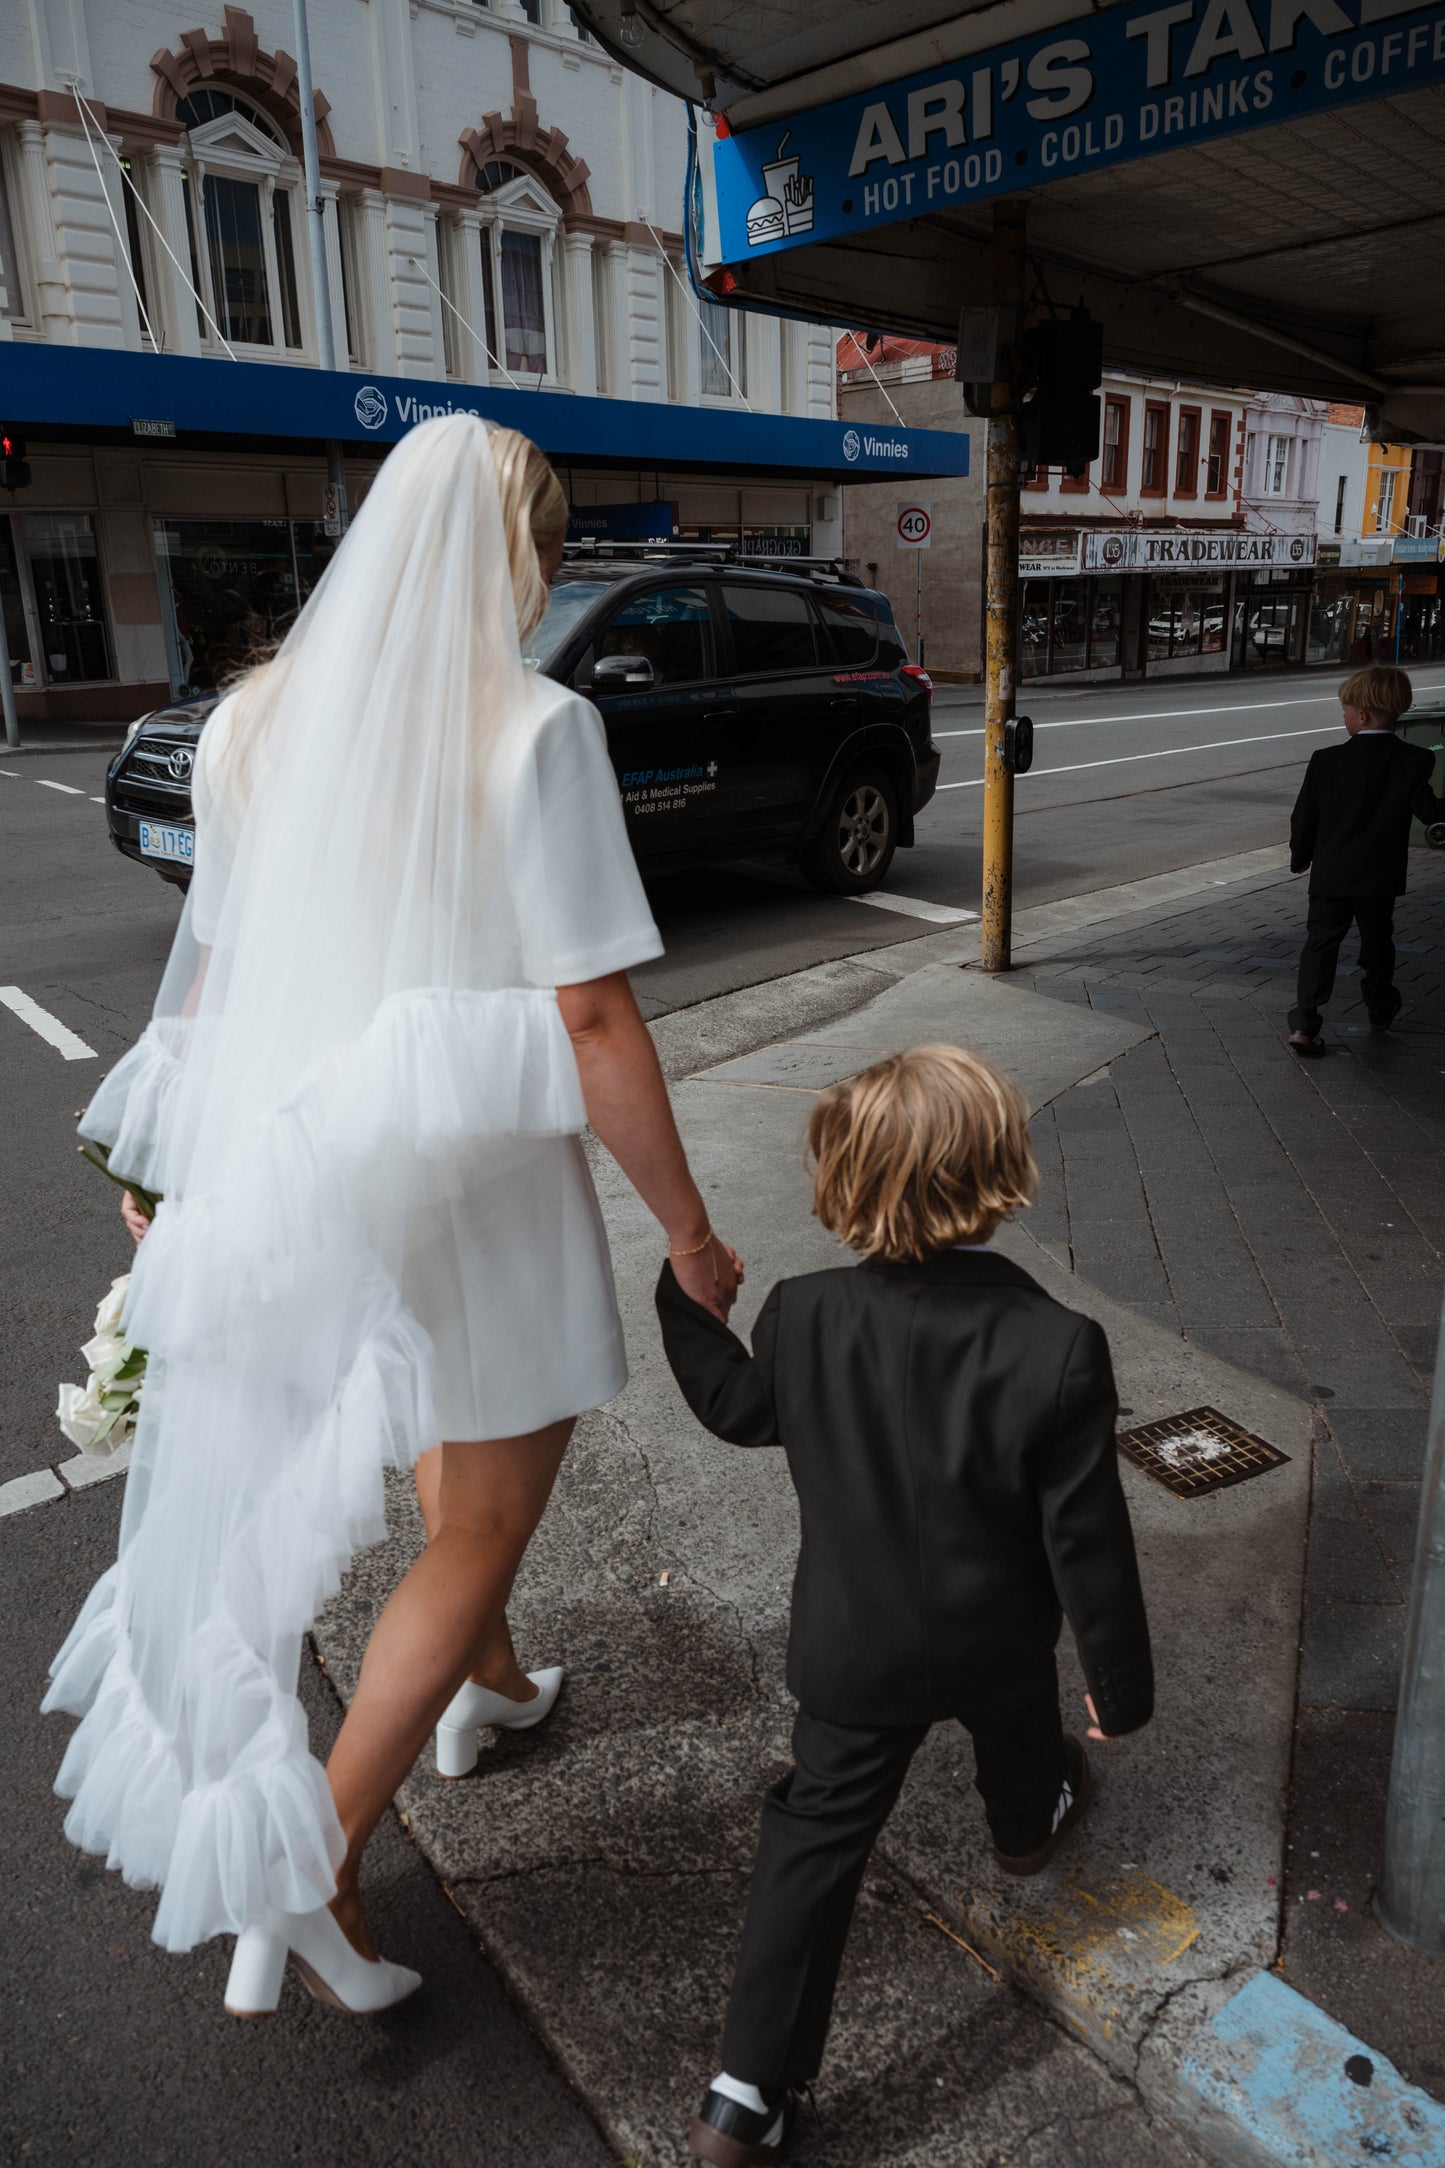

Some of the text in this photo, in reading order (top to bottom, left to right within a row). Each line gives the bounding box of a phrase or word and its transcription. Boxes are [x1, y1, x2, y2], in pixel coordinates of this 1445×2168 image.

[848, 39, 1094, 178] ARI'S
[864, 173, 916, 216] HOT
[927, 148, 1002, 199] FOOD
[1041, 112, 1124, 168] COLD
[1139, 69, 1274, 141] DRINKS
[395, 395, 479, 423] Vinni
[133, 421, 169, 435] ELIZABETH
[863, 436, 909, 458] Vinnies
[571, 517, 608, 529] Vinnies
[903, 517, 925, 533] 40
[1146, 539, 1273, 561] TRADEWEAR
[1160, 577, 1218, 586] TRADEWEAR
[622, 764, 703, 787] EFAP Australia
[625, 791, 640, 803] Aid
[642, 789, 648, 800] &
[650, 785, 681, 799] Medical
[683, 780, 716, 795] Supplies
[634, 799, 687, 815] 0408 514 816
